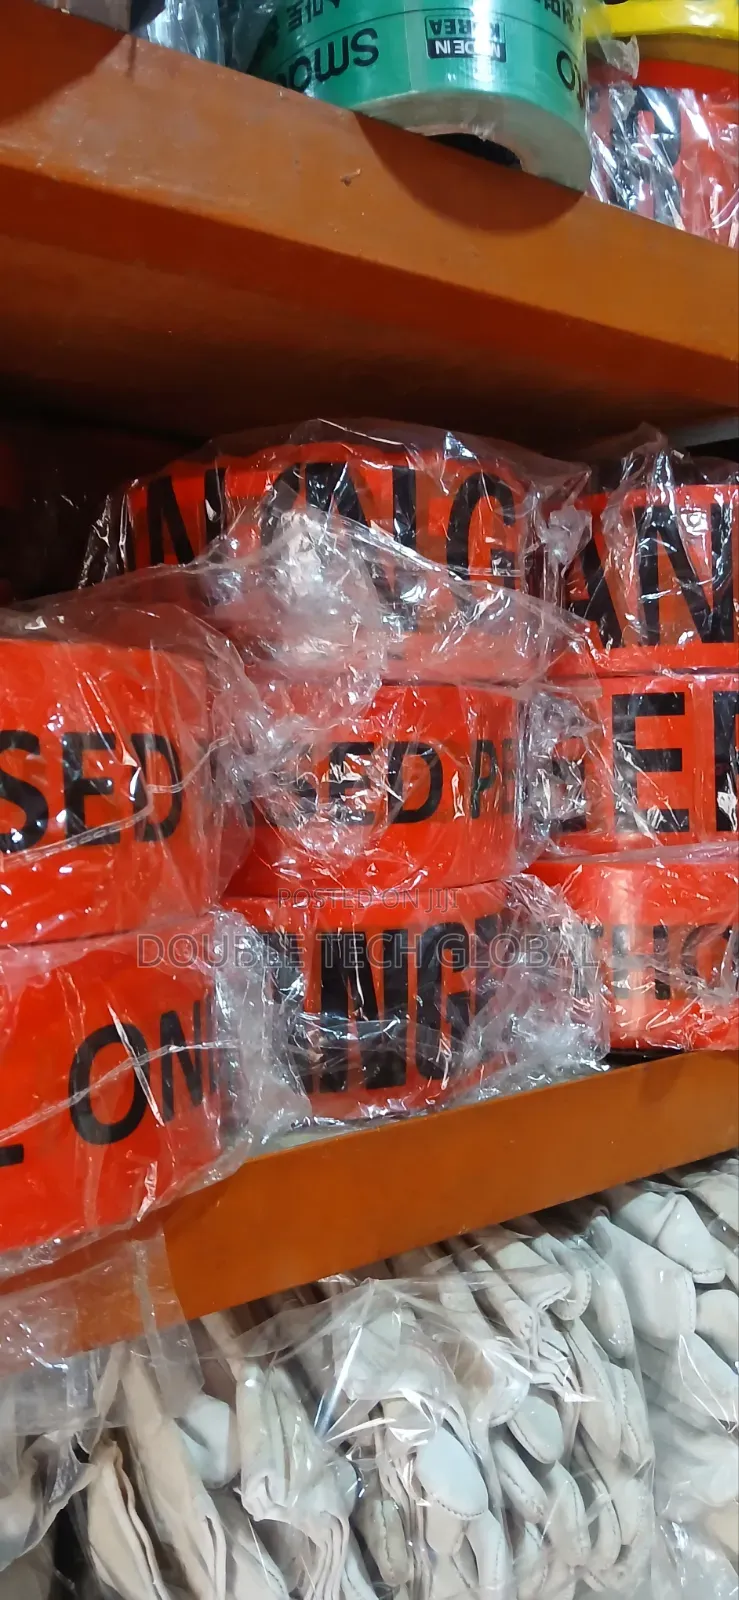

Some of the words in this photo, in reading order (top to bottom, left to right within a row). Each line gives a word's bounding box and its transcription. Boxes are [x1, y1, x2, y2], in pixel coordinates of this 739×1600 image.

[429, 18, 500, 36] KREA
[435, 40, 451, 55] IN
[453, 40, 501, 57] MDE
